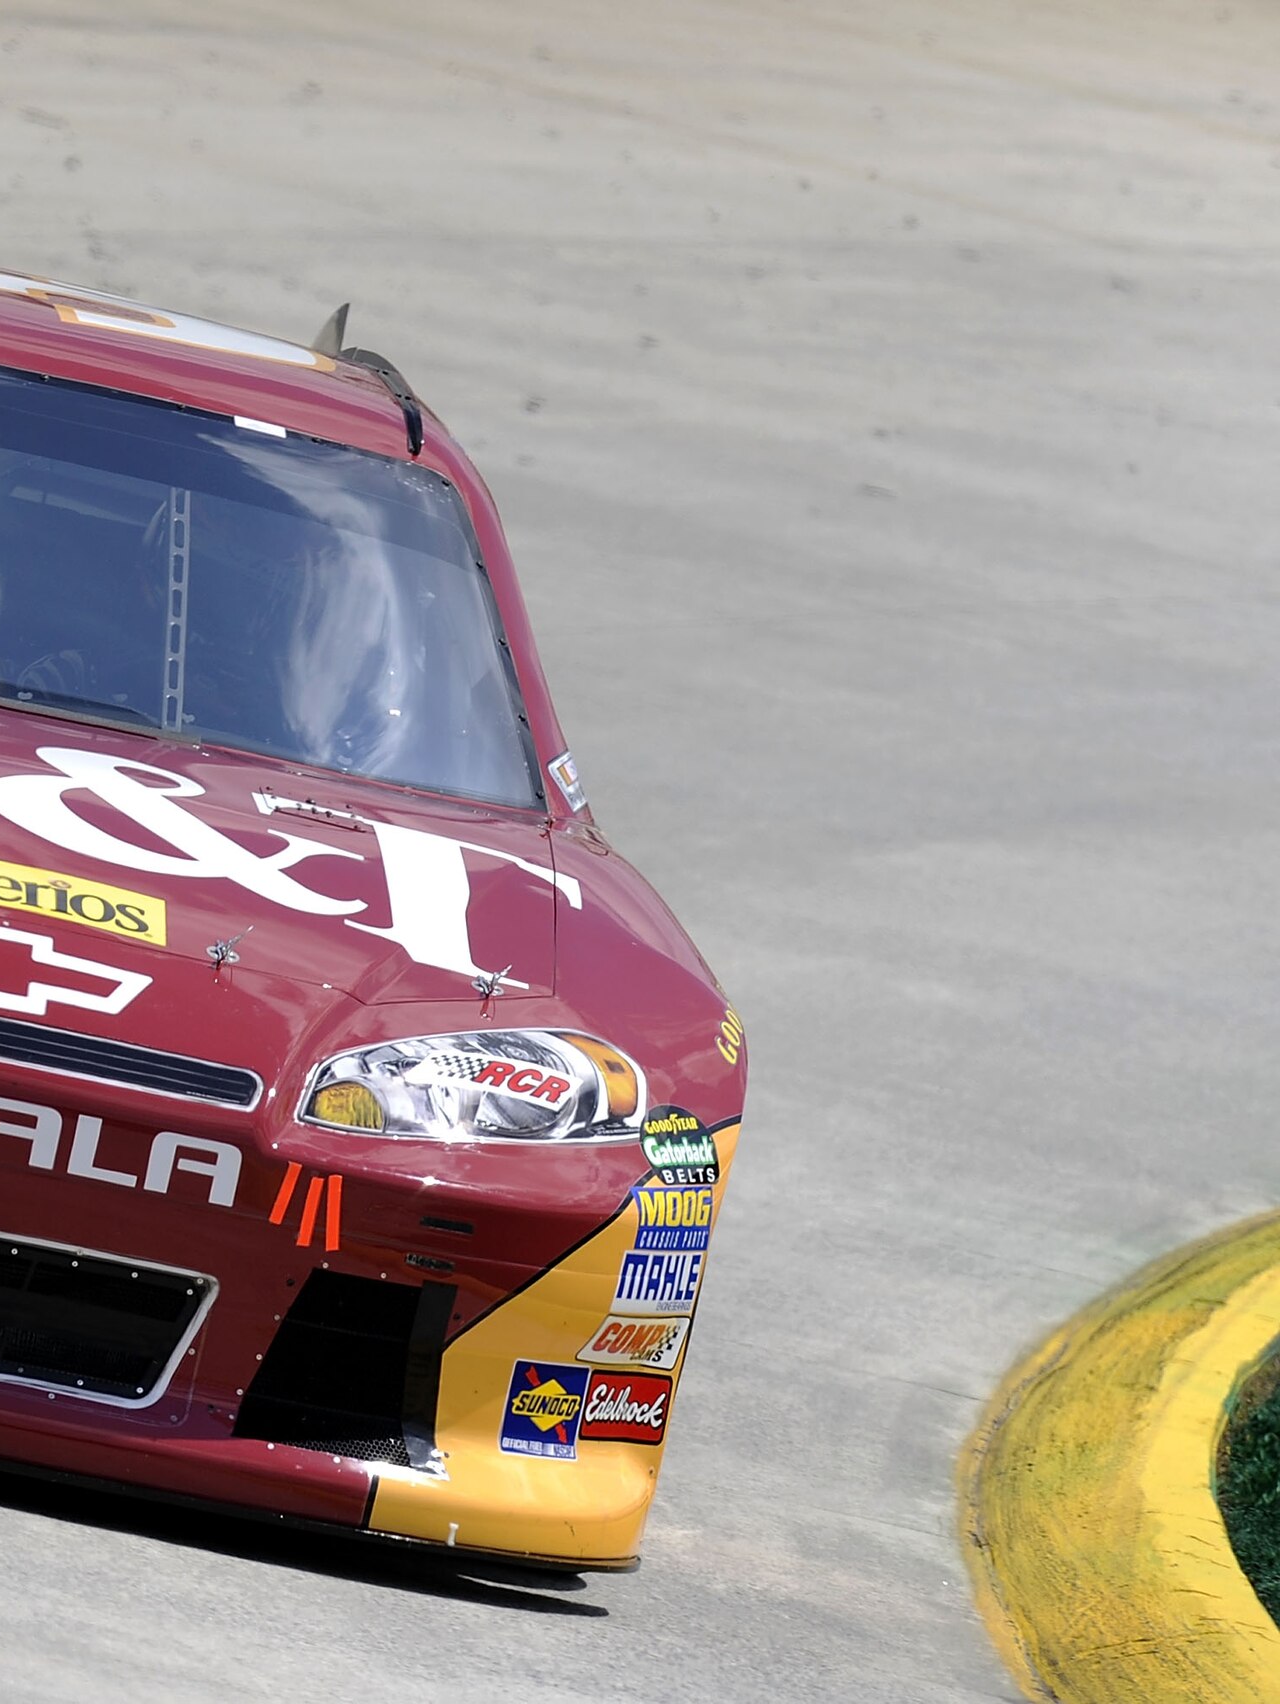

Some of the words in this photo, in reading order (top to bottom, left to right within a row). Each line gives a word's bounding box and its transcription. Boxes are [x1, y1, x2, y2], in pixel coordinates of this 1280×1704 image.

[473, 1061, 571, 1103] RCR
[644, 1113, 698, 1135] GOODYEAR
[643, 1136, 714, 1167] Gatorback
[662, 1168, 716, 1183] BELTS
[638, 1190, 711, 1227] MOOG
[639, 1231, 679, 1248] CHASSIS
[682, 1231, 706, 1248] PARTS
[616, 1254, 702, 1300] MAHLE
[592, 1322, 667, 1354] COMP
[515, 1393, 577, 1417] SUNOCO
[585, 1384, 666, 1428] Edelbrock
